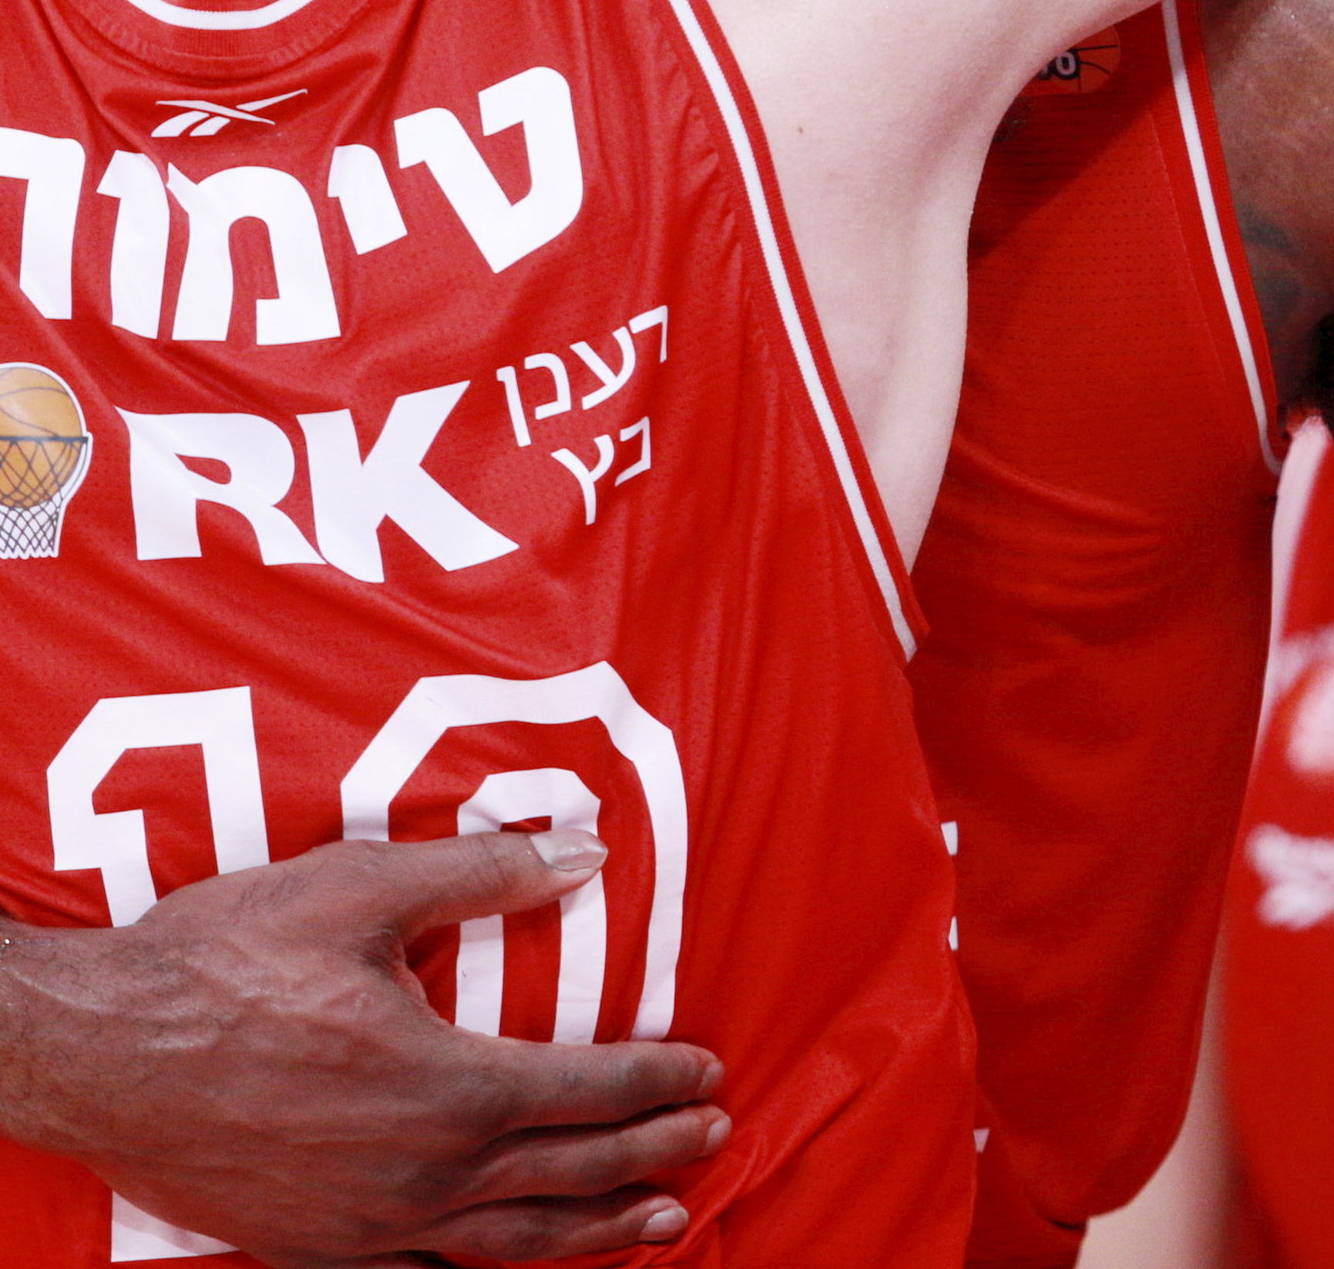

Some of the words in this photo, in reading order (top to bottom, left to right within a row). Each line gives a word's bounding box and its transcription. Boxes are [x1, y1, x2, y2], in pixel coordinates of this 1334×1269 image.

[496, 304, 669, 448] רענן
[116, 380, 520, 584] RK
[550, 416, 652, 526] כץ
[46, 660, 688, 1263] 10
